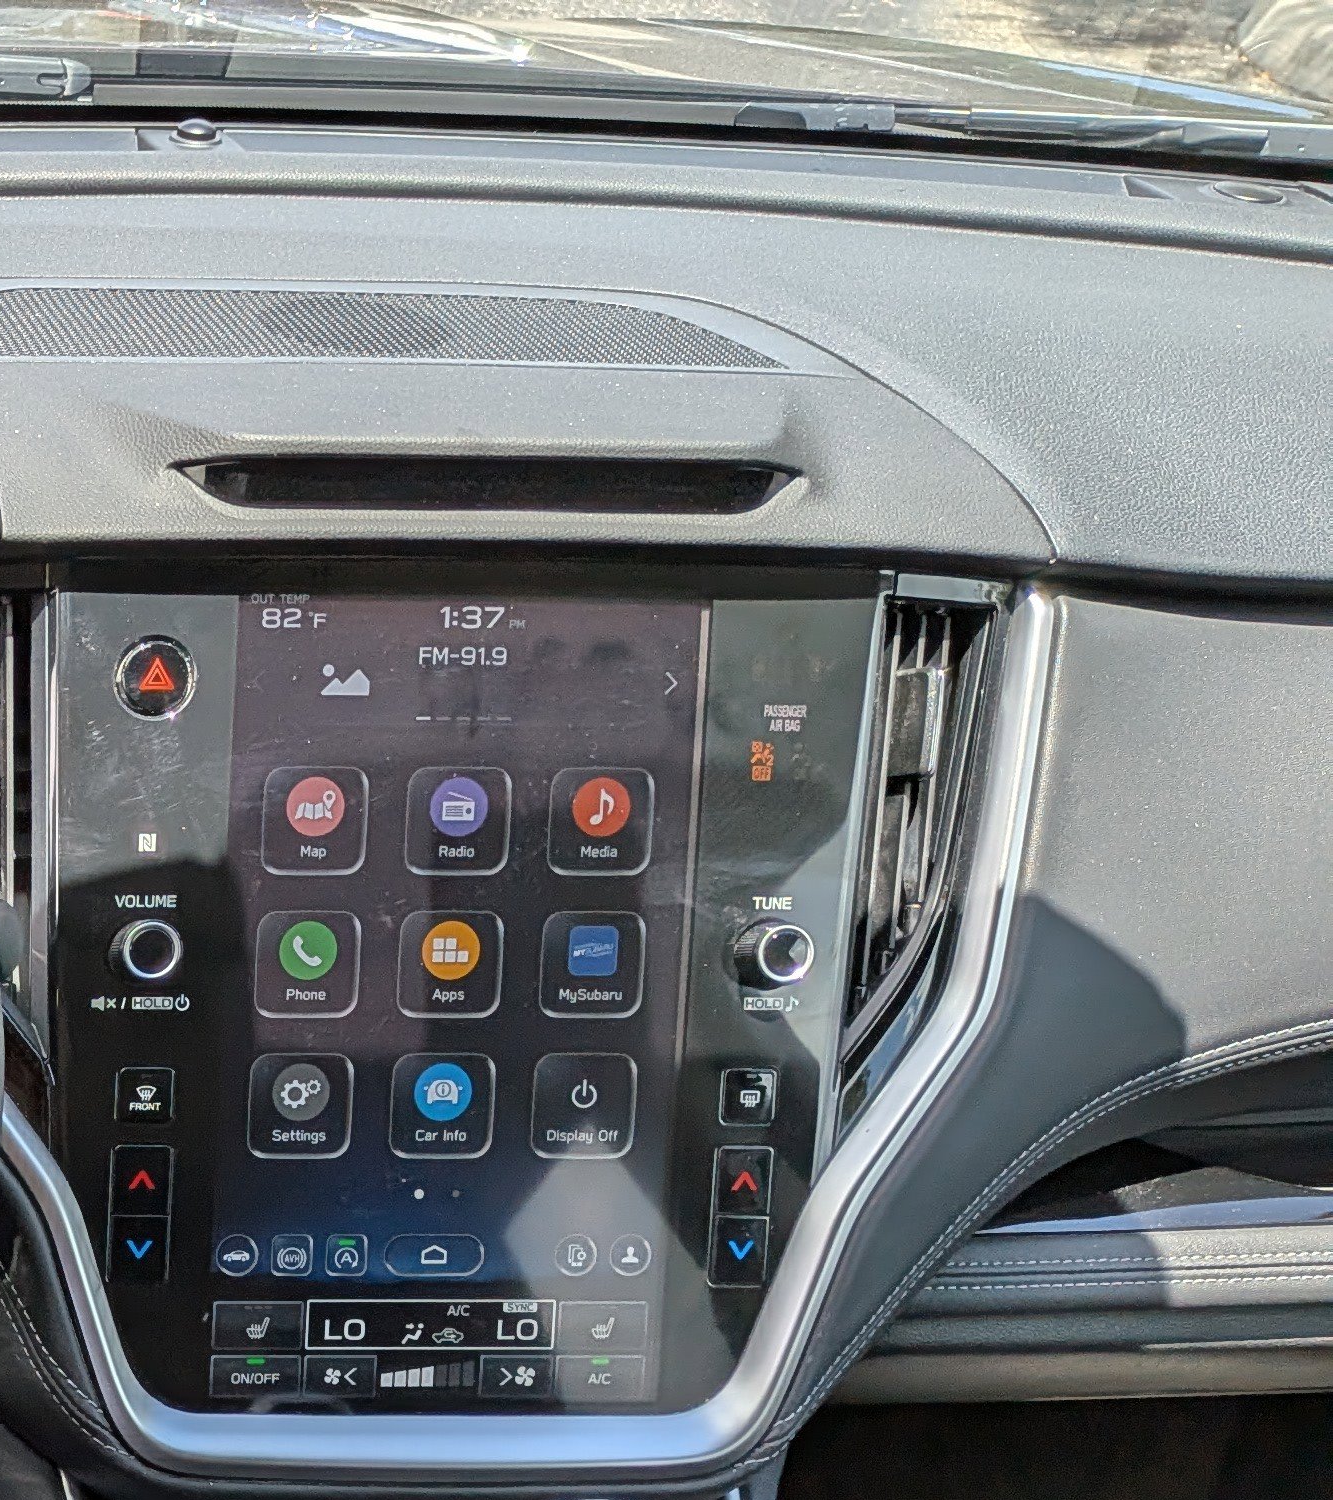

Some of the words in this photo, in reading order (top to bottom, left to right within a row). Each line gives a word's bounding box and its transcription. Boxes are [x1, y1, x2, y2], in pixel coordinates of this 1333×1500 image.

[250, 593, 276, 604] OUT
[281, 593, 311, 604] TEMP
[261, 608, 302, 629] 82
[439, 605, 506, 630] 1:37
[508, 619, 526, 629] PM
[418, 646, 508, 666] FM-91.9
[763, 704, 807, 718] PASSENGER
[769, 719, 783, 732] AIR
[784, 719, 801, 732] BAG
[299, 845, 327, 860] Map
[437, 844, 476, 859] Radio
[579, 844, 619, 859] Media
[114, 894, 178, 909] VOLUME
[752, 897, 792, 911] TUNE
[285, 988, 327, 1002] Phone
[432, 988, 466, 1003] Apps
[558, 988, 623, 1003] MySubaru
[132, 996, 173, 1010] HOLD
[745, 998, 783, 1011] HOLD
[129, 1101, 162, 1112] FRONT
[271, 1128, 327, 1145] Settings
[415, 1129, 439, 1142] Car
[442, 1128, 467, 1142] Info
[546, 1128, 593, 1145] Display
[598, 1128, 619, 1142] Off
[284, 1254, 301, 1263] AVH
[446, 1304, 471, 1317] A/C
[506, 1303, 535, 1313] SYNC
[323, 1318, 366, 1342] LO
[496, 1318, 539, 1342] LO
[230, 1372, 281, 1385] ON/OFF
[587, 1372, 612, 1386] A/C
